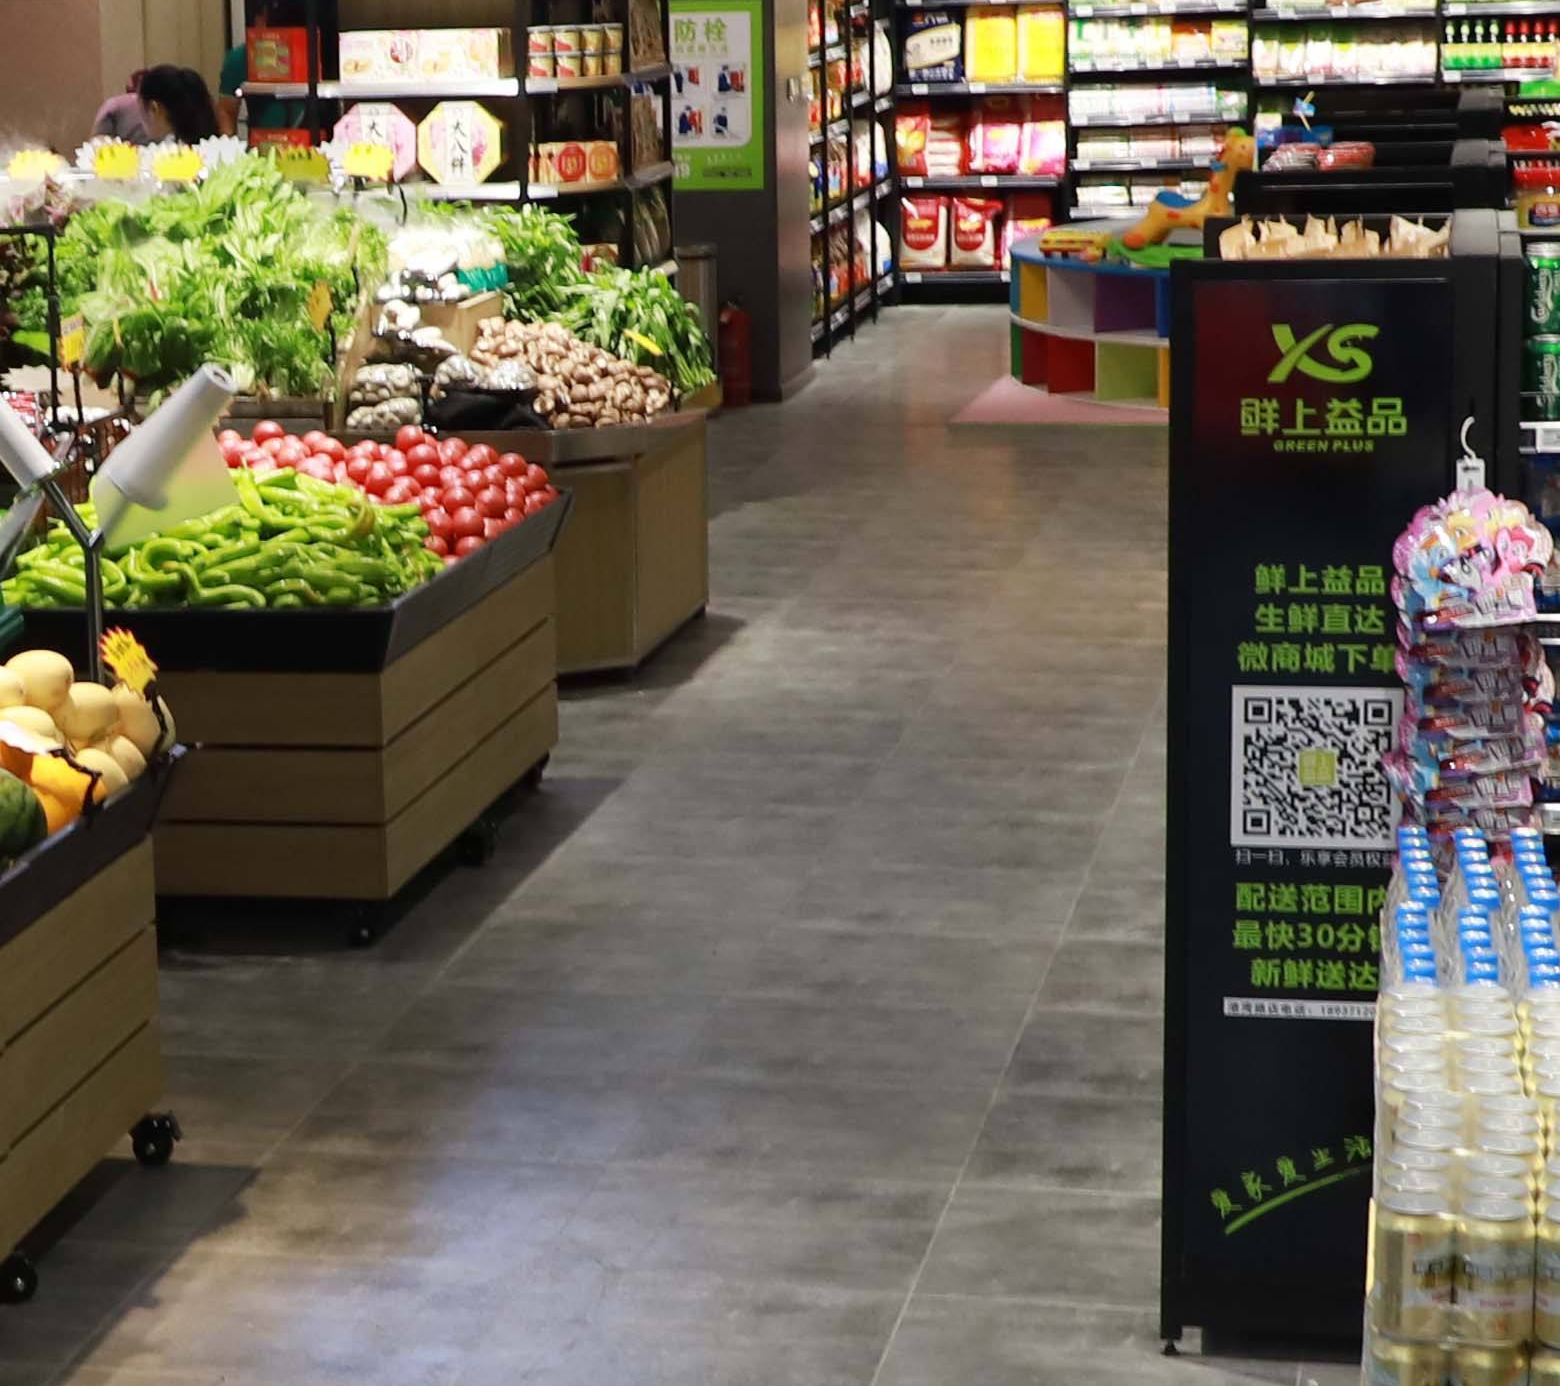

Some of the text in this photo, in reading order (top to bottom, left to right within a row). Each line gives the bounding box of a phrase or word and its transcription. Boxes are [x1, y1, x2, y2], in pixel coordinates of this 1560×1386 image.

[1267, 322, 1379, 384] XS
[1241, 397, 1407, 436] 鲜上益品
[1273, 439, 1375, 453] GREEN PLUS
[1255, 563, 1385, 595] 鲜上益品
[1255, 602, 1385, 635] 生鲜直达
[1237, 641, 1396, 674] 微商城下单
[1235, 882, 1387, 916] 配送范围内
[1250, 957, 1378, 991] 新鲜送达
